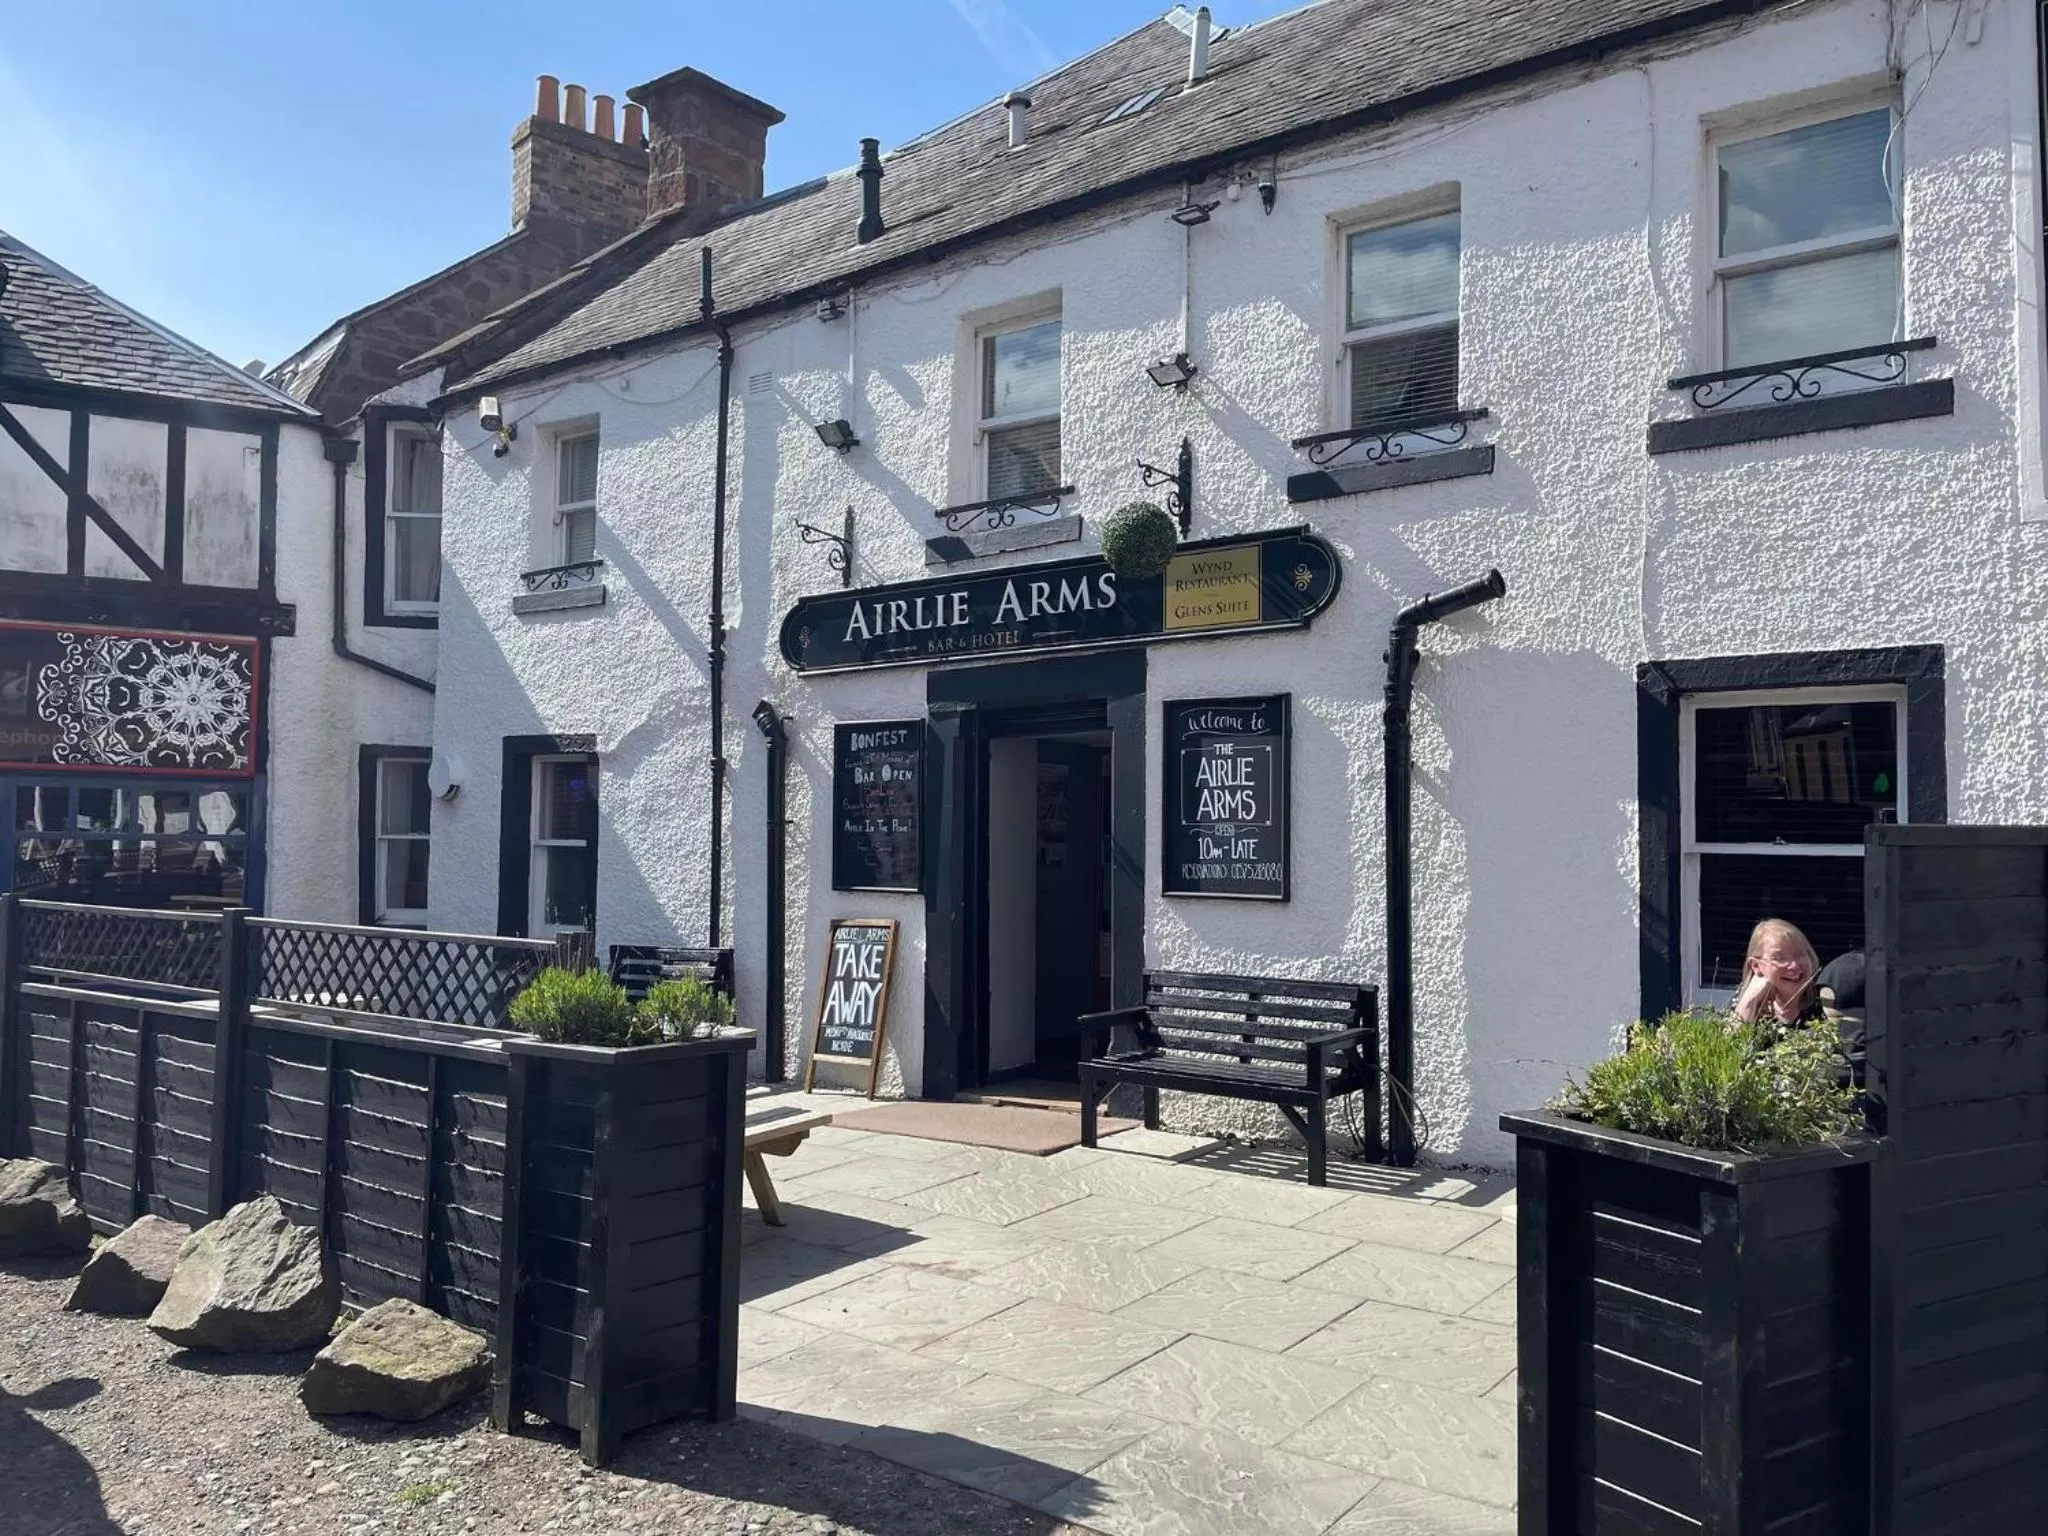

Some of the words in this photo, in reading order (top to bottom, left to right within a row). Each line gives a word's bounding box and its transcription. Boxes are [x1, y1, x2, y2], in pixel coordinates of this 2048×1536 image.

[1192, 561, 1233, 575] WYND
[1176, 572, 1249, 592] RESTAURANT
[843, 591, 969, 641] AIRLIE
[995, 573, 1117, 623] ARMS
[1175, 603, 1212, 619] GLENS
[1215, 600, 1249, 615] SUITE
[928, 637, 954, 652] BAR
[972, 630, 1020, 648] HOTEL
[851, 730, 907, 751] BONFEST
[1213, 744, 1234, 755] THE
[1195, 757, 1255, 787] AIRLIE
[1196, 789, 1256, 821] ARMS
[865, 928, 890, 942] ARMS
[835, 943, 884, 979] TAKE
[821, 980, 883, 1025] AWAY
